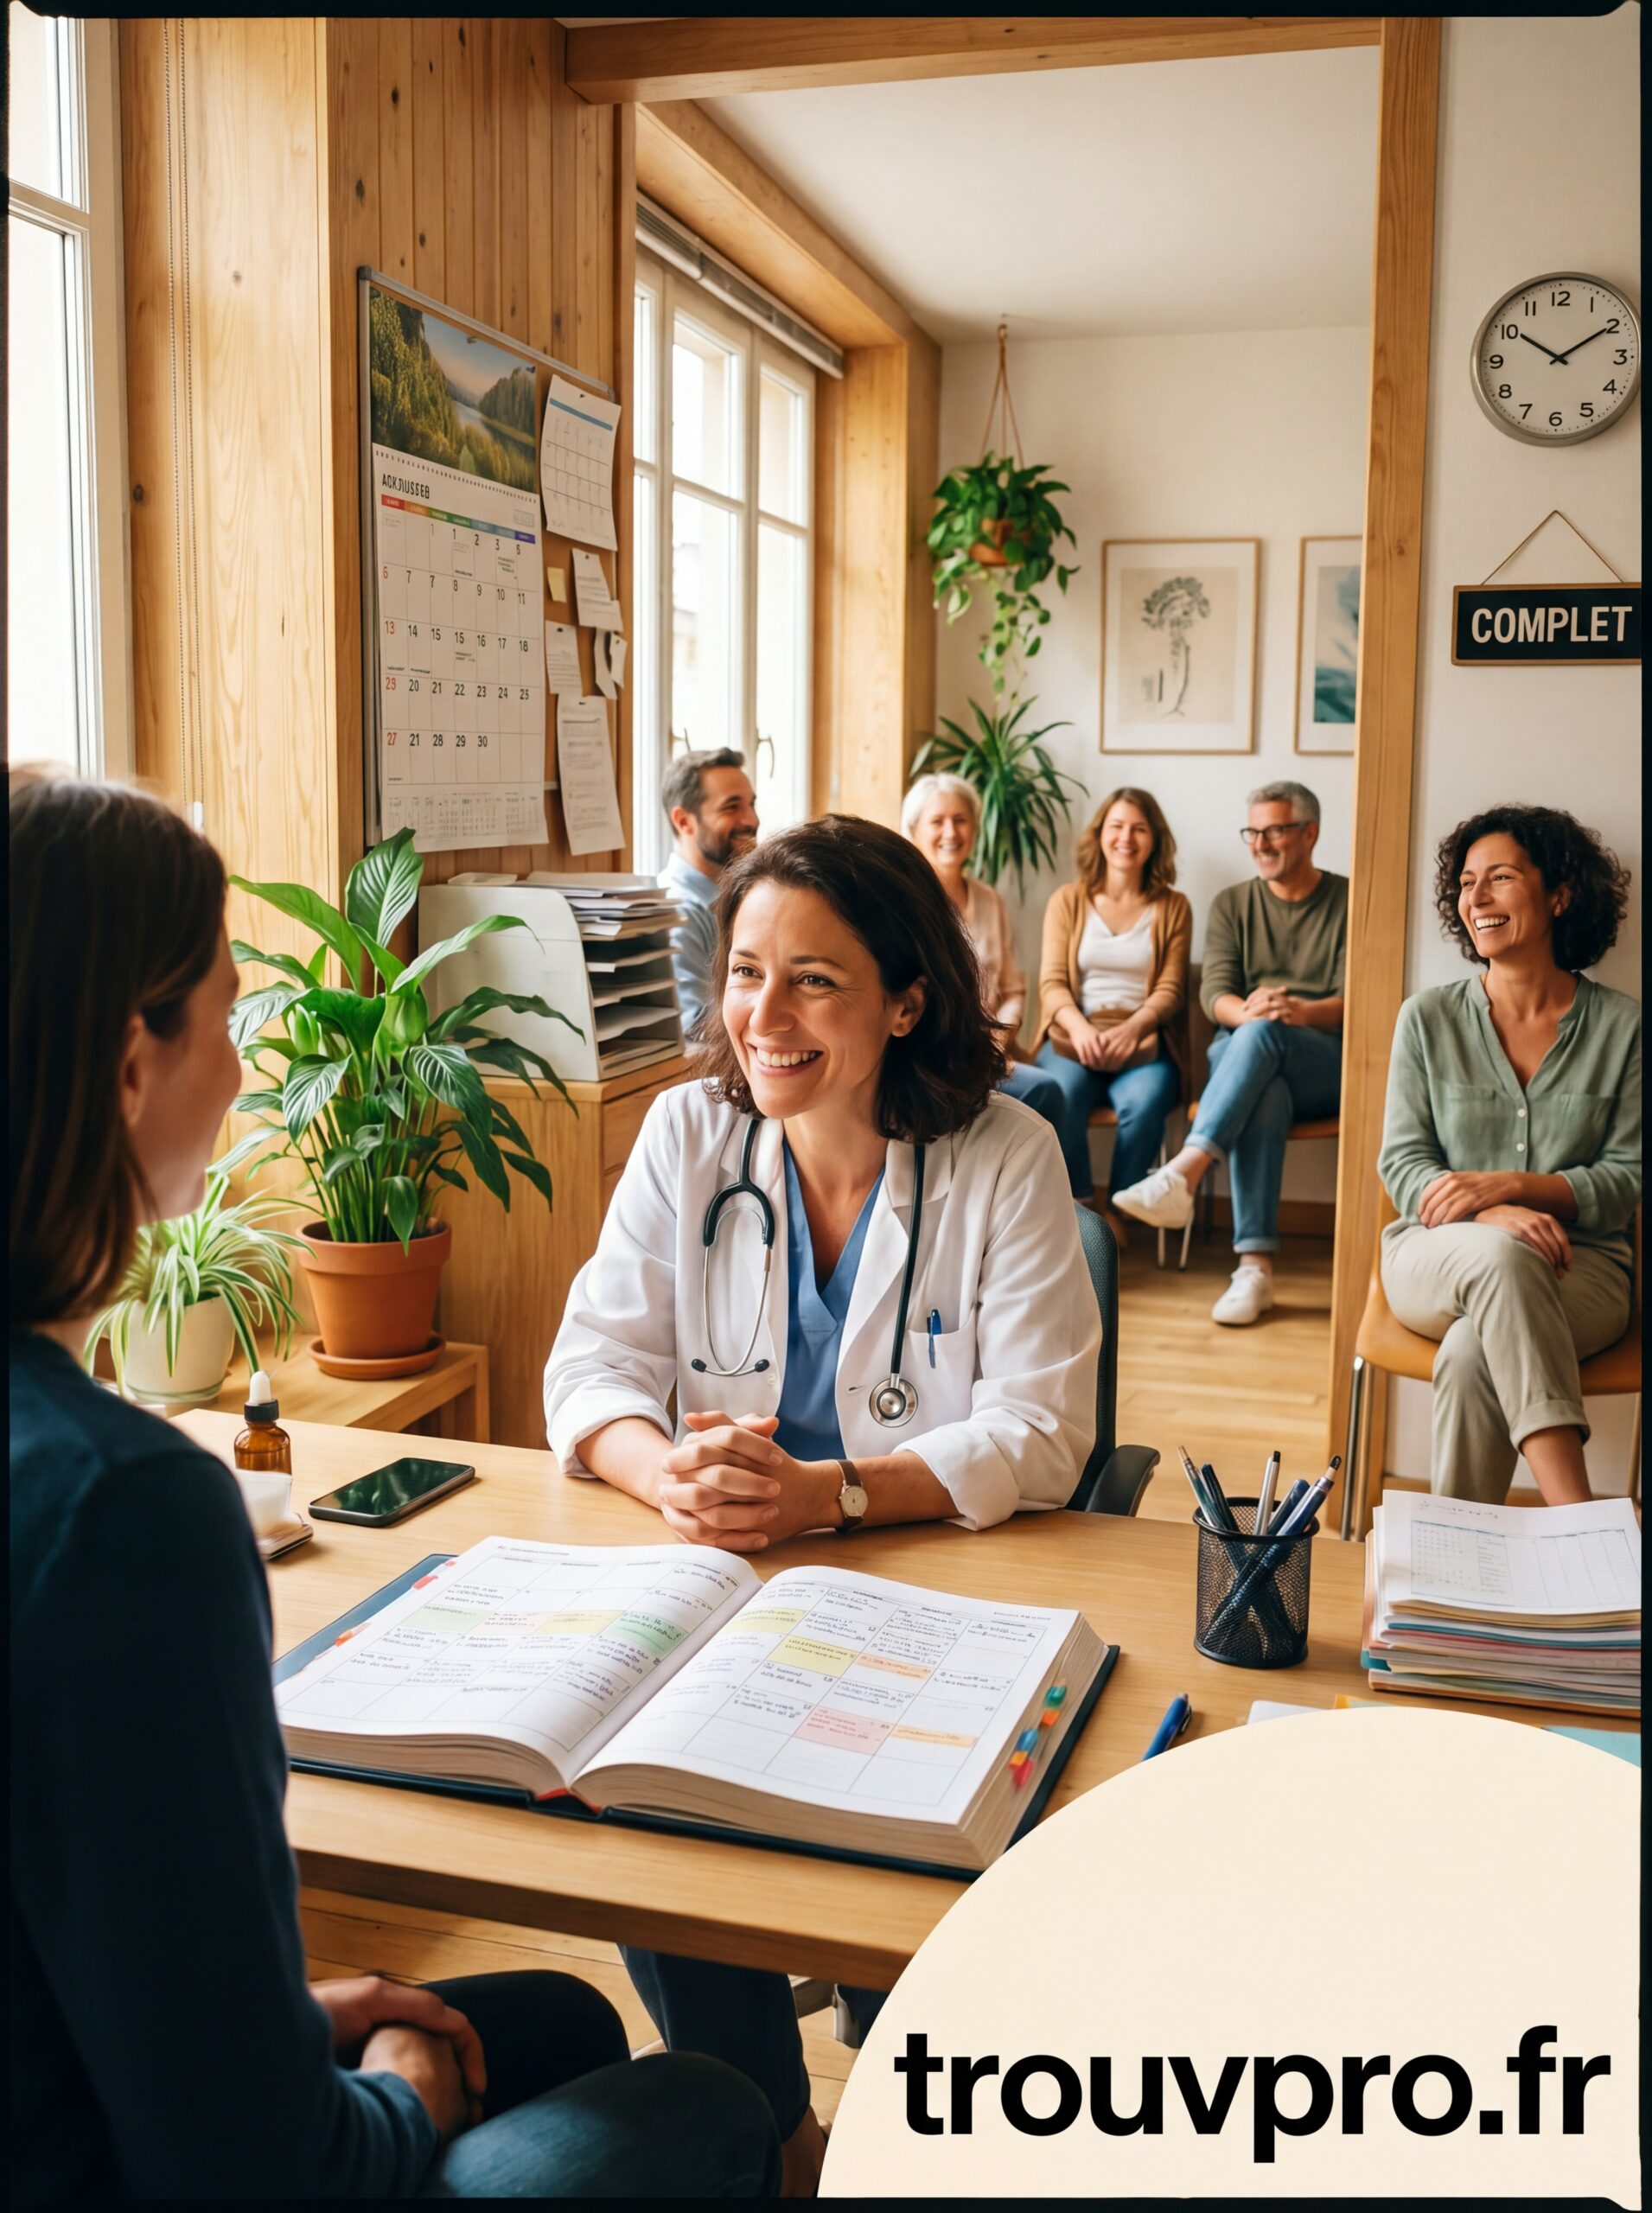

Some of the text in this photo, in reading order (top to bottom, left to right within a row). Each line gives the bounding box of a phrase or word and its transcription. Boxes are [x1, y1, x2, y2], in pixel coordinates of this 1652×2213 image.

[1552, 291, 1570, 306] 12
[1590, 297, 1594, 313] 1
[1525, 301, 1536, 316] 11
[1502, 324, 1518, 340] 10
[1606, 319, 1619, 334] 2
[1489, 354, 1503, 369] 9
[1613, 349, 1627, 365] 3
[1499, 384, 1512, 399] 8
[1603, 379, 1617, 394] 4
[1520, 404, 1533, 419] 7
[1580, 403, 1593, 418] 5
[1549, 411, 1562, 426] 6
[475, 533, 480, 546] 2
[495, 539, 500, 551] 3
[383, 565, 388, 579] 6
[406, 570, 411, 584] 7
[453, 579, 458, 592] 8
[476, 584, 482, 596] 9
[496, 588, 505, 601] 10
[518, 592, 526, 604] 11
[1472, 607, 1632, 642] COMPLET
[385, 620, 395, 635] 13
[408, 624, 418, 637] 14
[431, 628, 441, 641] 15
[476, 635, 486, 647] 16
[497, 637, 507, 649] 17
[519, 640, 528, 653] 18
[409, 679, 419, 692] 20
[431, 681, 442, 694] 21
[454, 683, 465, 696] 22
[476, 685, 487, 698] 23
[498, 686, 508, 699] 24
[520, 688, 529, 700] 25
[386, 731, 488, 748] 27 21 28 29 30
